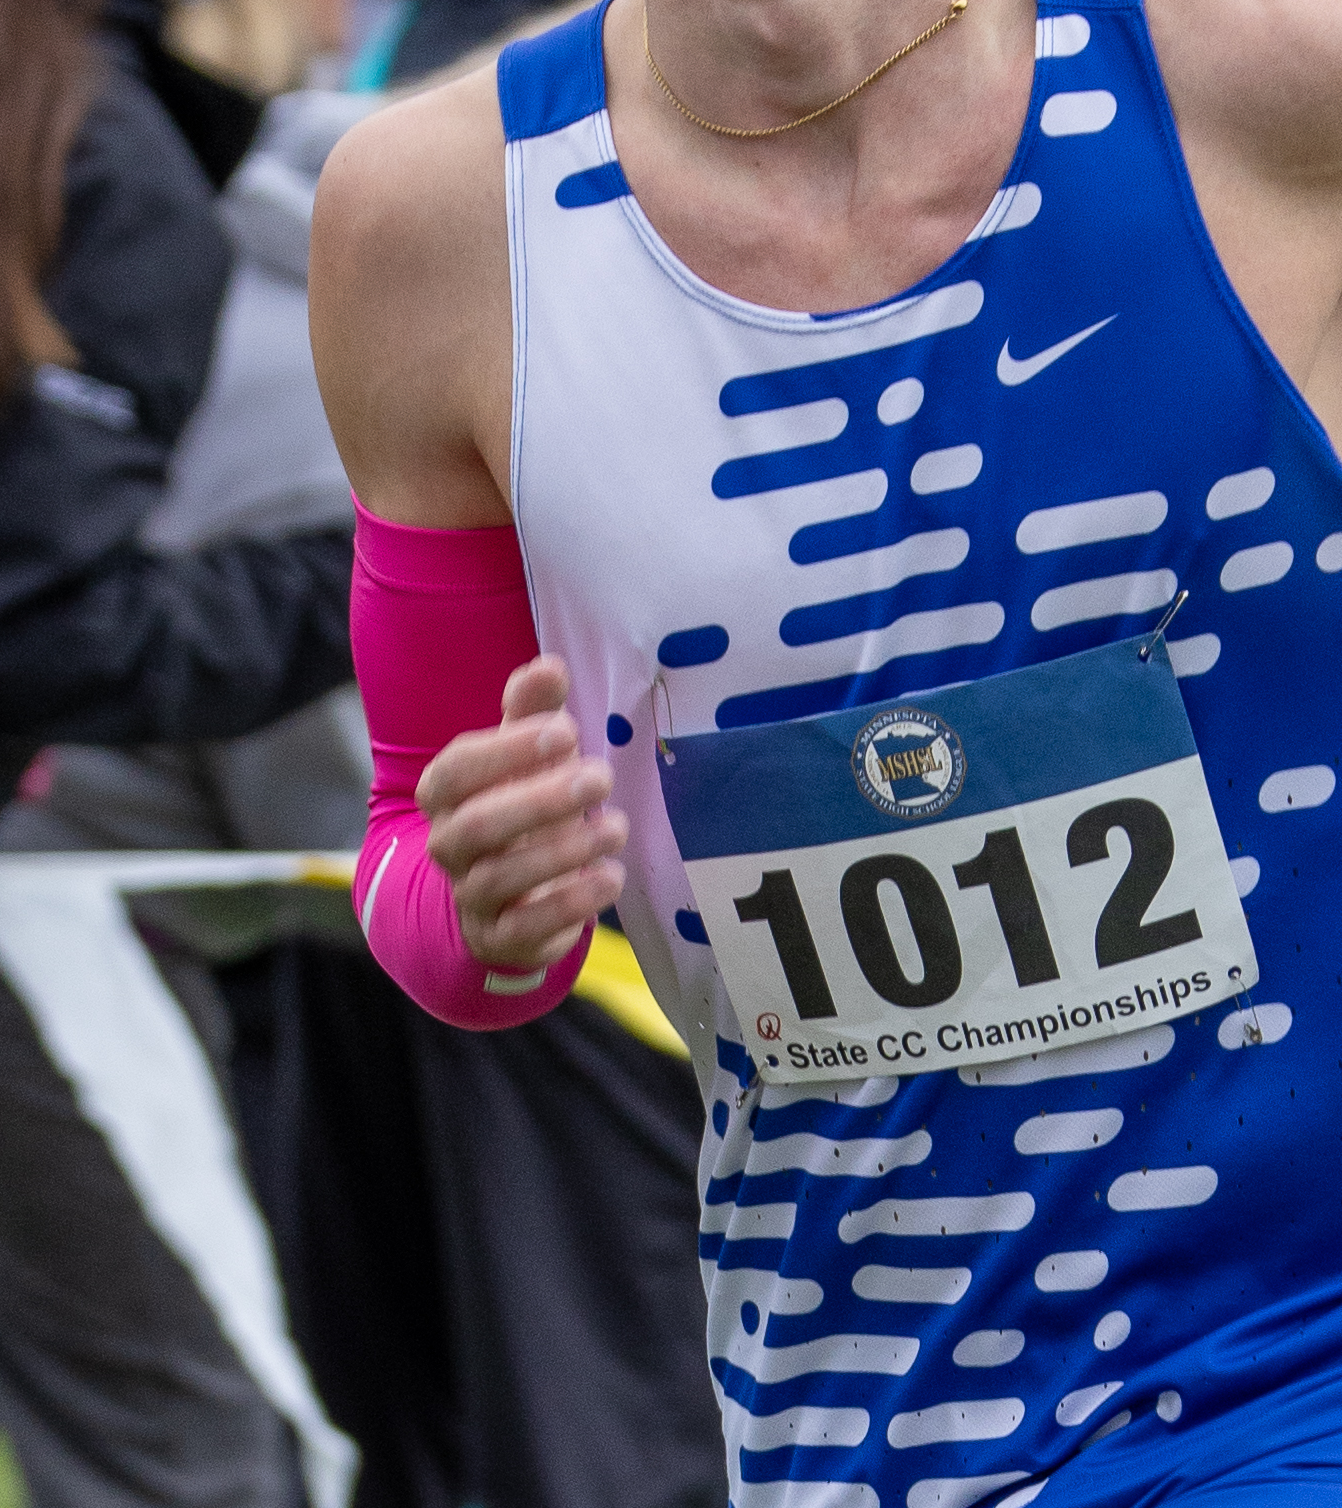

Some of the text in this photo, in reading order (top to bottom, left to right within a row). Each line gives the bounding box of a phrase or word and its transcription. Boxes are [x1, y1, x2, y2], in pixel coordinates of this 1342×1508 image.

[875, 745, 943, 782] MSHSL
[732, 797, 1204, 1022] 1012
[786, 971, 1213, 1070] State CC Championships
